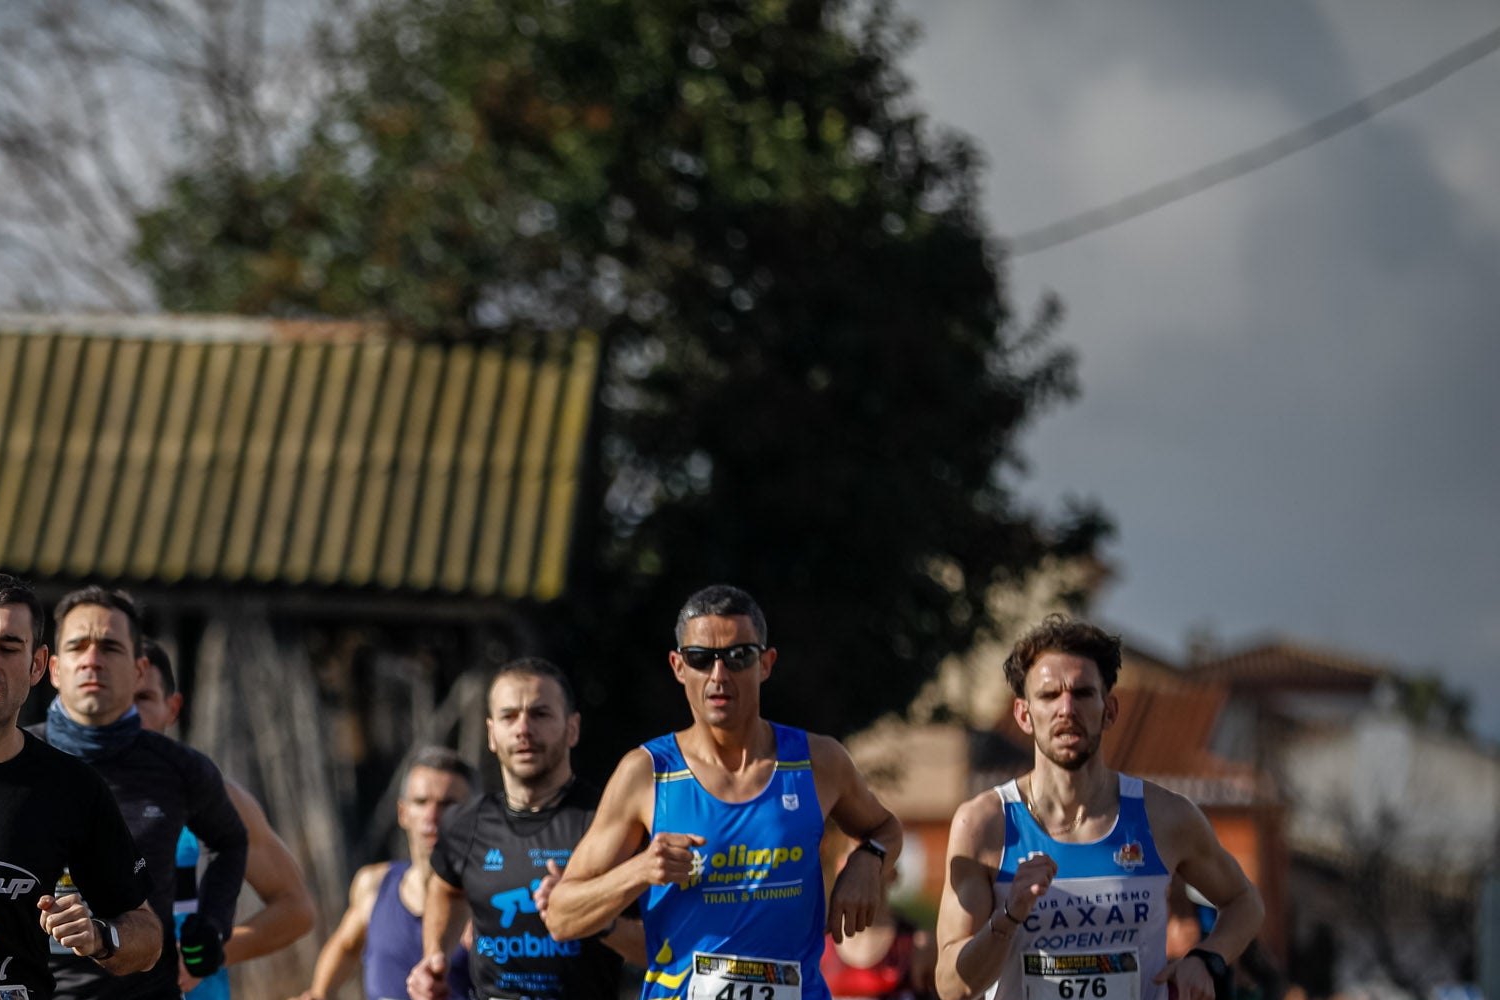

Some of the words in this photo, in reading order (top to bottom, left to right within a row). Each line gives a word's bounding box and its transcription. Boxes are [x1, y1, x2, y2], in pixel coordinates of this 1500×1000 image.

[711, 844, 803, 869] olimpo
[703, 892, 738, 905] TRAIL
[741, 891, 750, 903] &
[752, 885, 803, 901] RUNNING
[1066, 890, 1150, 907] ATLETISMO
[1023, 902, 1149, 932] CAXAR
[1058, 977, 1107, 1000] 676
